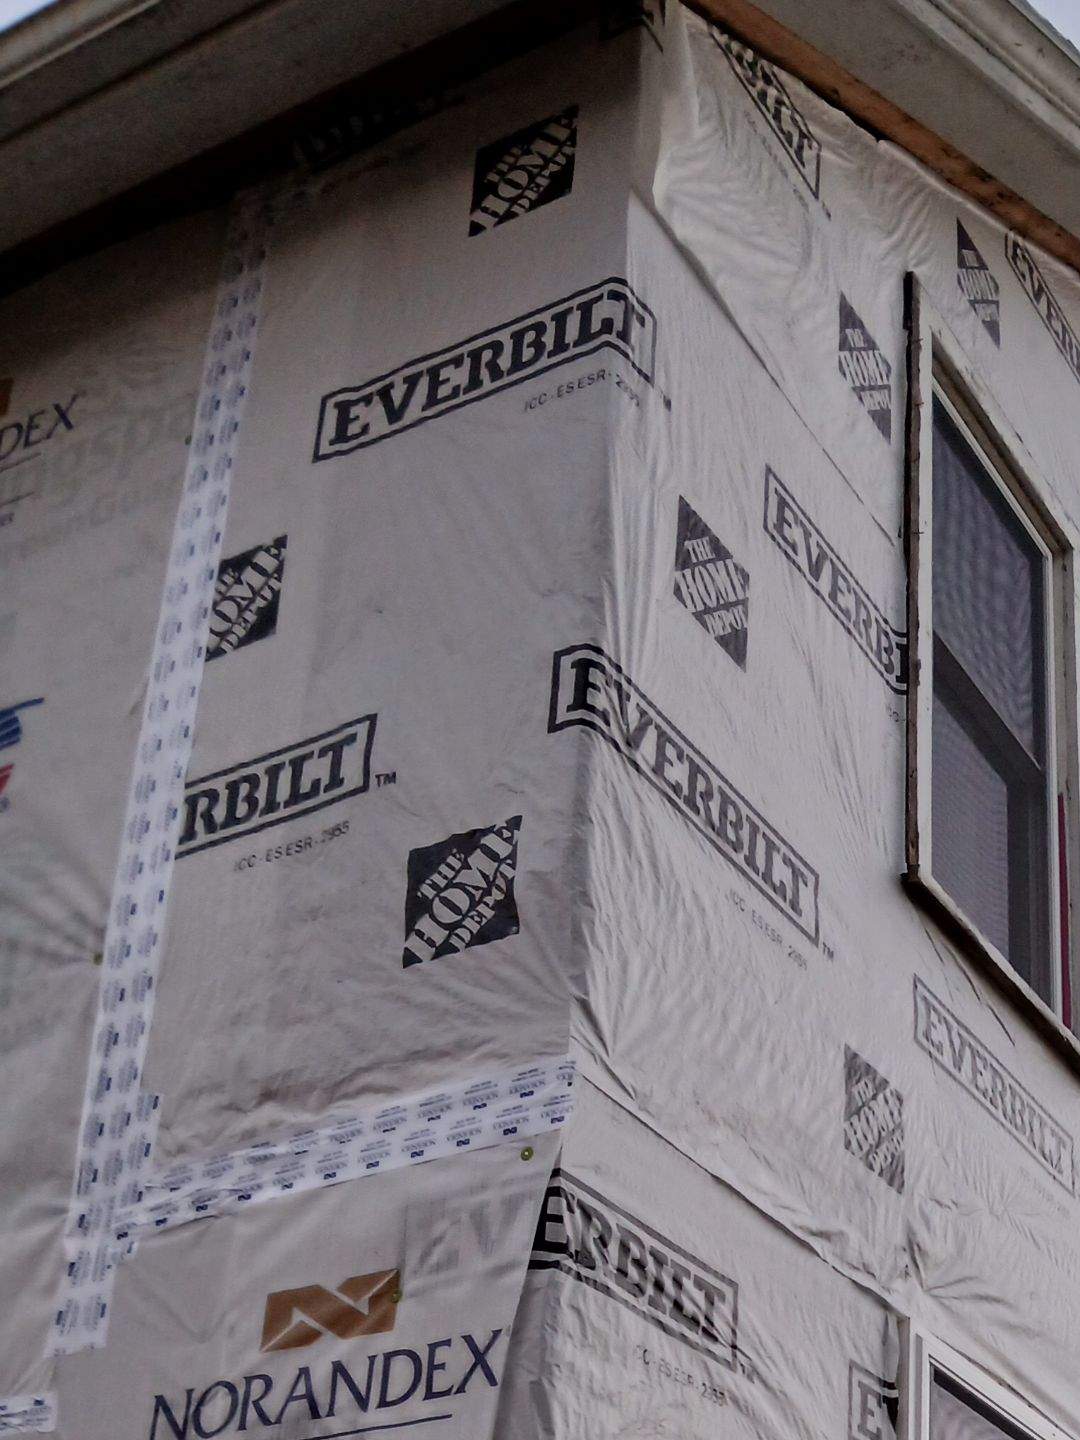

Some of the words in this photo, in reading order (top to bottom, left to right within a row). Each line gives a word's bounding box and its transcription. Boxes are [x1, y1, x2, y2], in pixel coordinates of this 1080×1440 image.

[469, 115, 577, 228] HOME
[328, 289, 645, 446] EVERBILT
[674, 558, 749, 613] HOME
[375, 770, 397, 788] TM
[566, 657, 808, 918] EVERBILT
[403, 823, 520, 962] HOME
[416, 848, 464, 900] THE
[448, 859, 516, 952] DEPOT
[923, 995, 1067, 1176] EVERBILT
